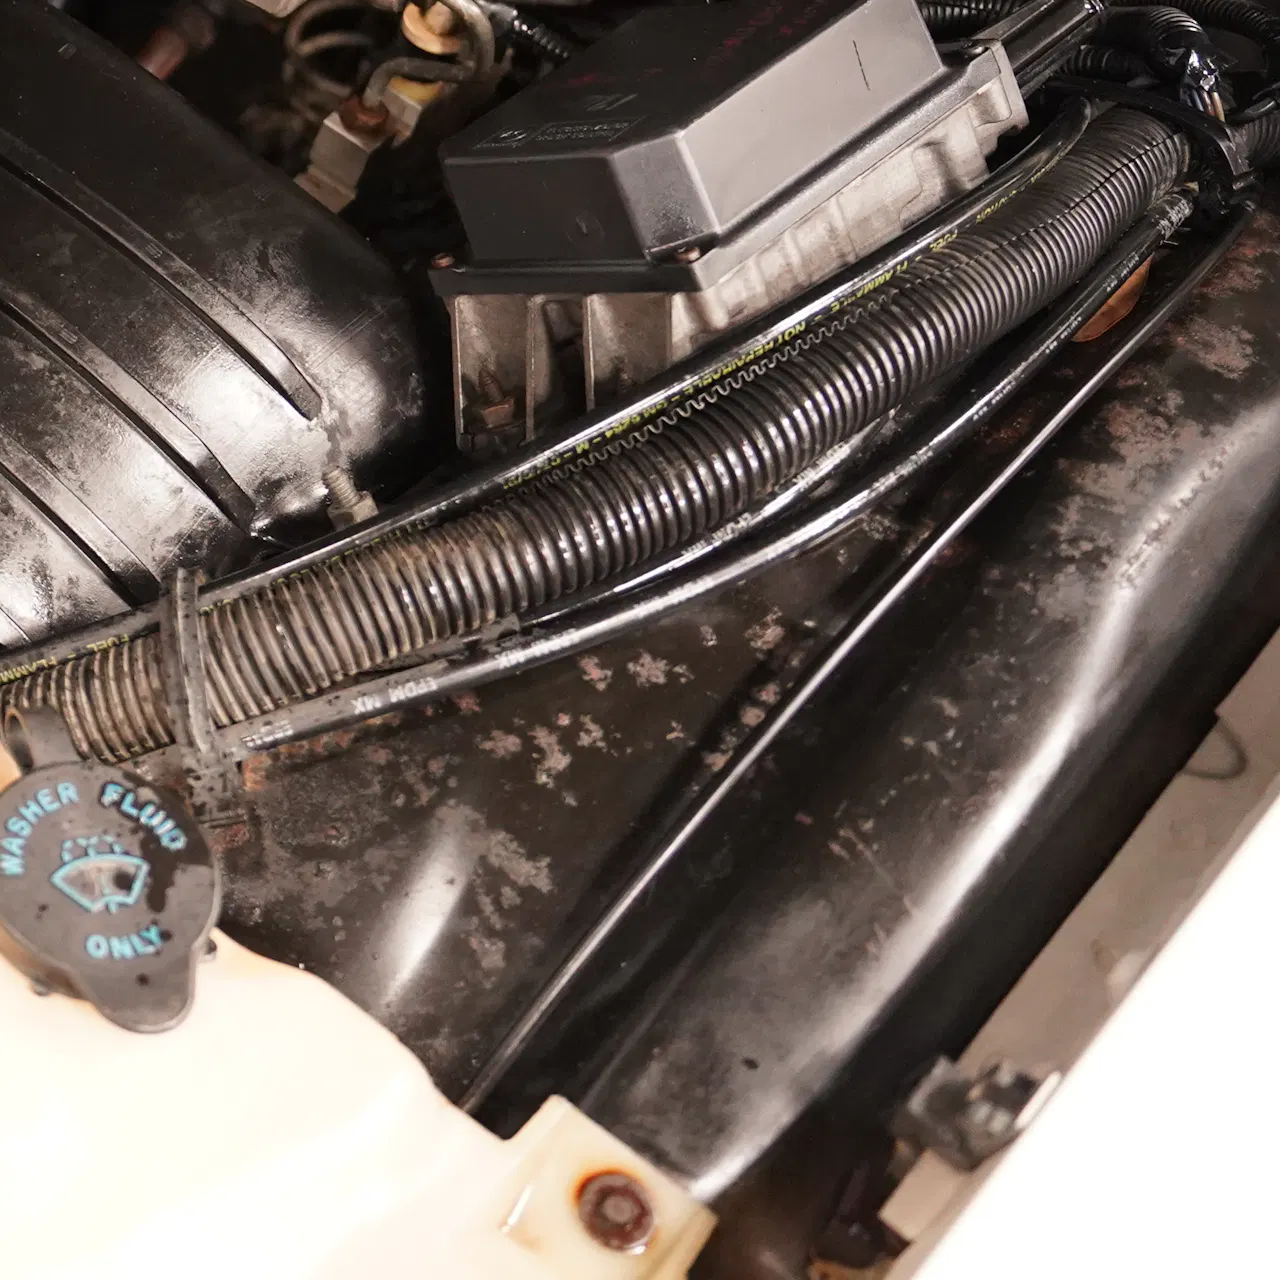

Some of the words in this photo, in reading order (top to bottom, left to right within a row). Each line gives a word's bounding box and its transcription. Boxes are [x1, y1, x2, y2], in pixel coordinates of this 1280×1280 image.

[774, 318, 808, 344] NOT
[682, 339, 775, 396] REPAIRABLE
[86, 632, 129, 653] FUEL
[386, 675, 437, 702] EPDM
[349, 691, 382, 714] MX
[99, 780, 189, 853] FLUID
[85, 923, 163, 960] ONLY
